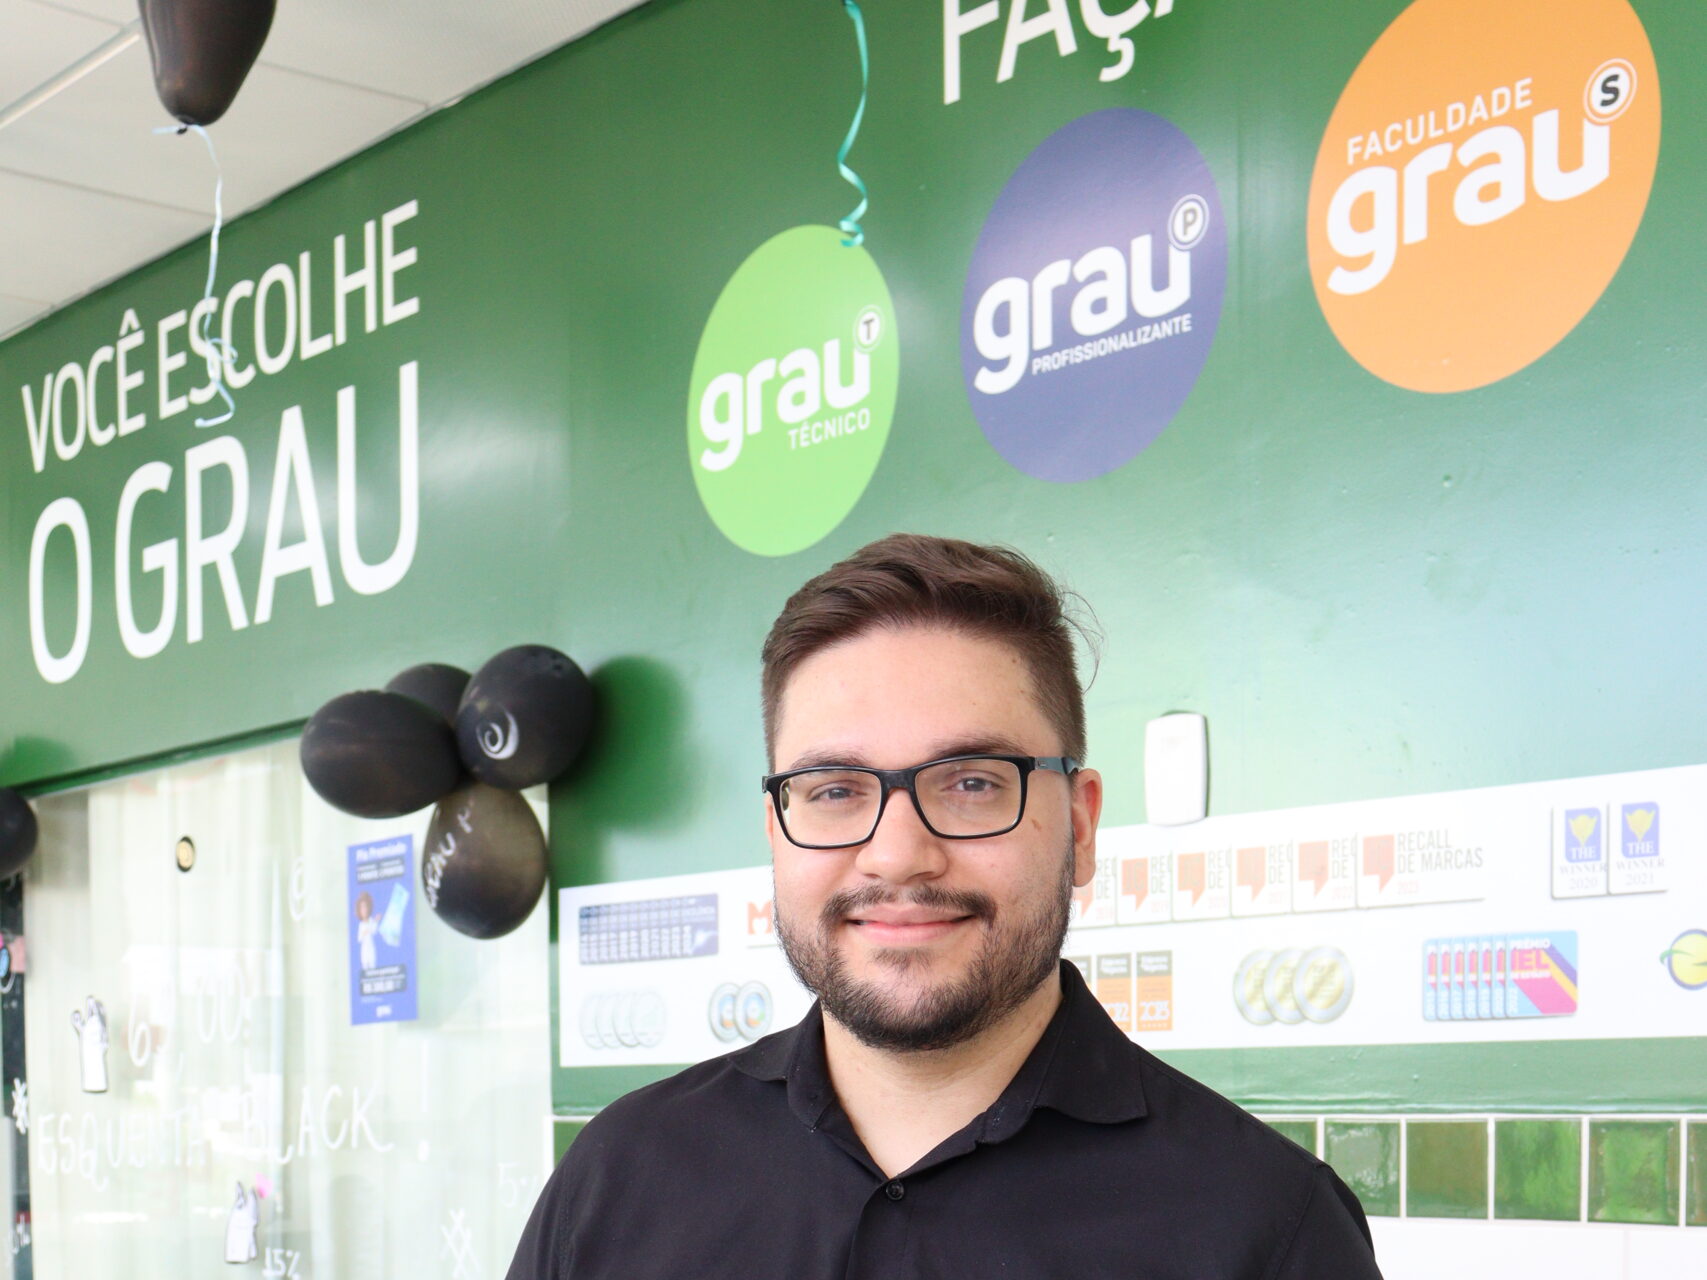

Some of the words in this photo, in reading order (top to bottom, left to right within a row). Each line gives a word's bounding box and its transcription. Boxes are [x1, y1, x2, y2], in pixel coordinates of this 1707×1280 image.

[943, 0, 1175, 105] FAÇ
[1346, 77, 1533, 165] FACULDADE
[1326, 108, 1610, 296] grau
[973, 234, 1192, 395] grau
[21, 308, 147, 474] VOCÊ
[157, 199, 420, 420] ESCOLHE
[1031, 313, 1193, 376] PROFISSIONALIZANTE
[699, 338, 871, 472] grau
[787, 407, 871, 451] TÉCNICO
[28, 497, 92, 684] O
[114, 360, 419, 659] GRAU
[1397, 828, 1454, 852] RECALL
[1626, 841, 1655, 856] THE
[1397, 852, 1416, 874] DE
[1420, 846, 1484, 872] MARCAS
[1568, 845, 1597, 860] THE
[1615, 857, 1665, 871] WINNER
[1207, 869, 1225, 889] DE
[1268, 864, 1285, 885] DE
[1331, 858, 1349, 879] DE
[1559, 863, 1607, 876] WINNER
[1625, 872, 1654, 887] 2021
[1150, 873, 1166, 894] DE
[1568, 876, 1598, 890] 2020
